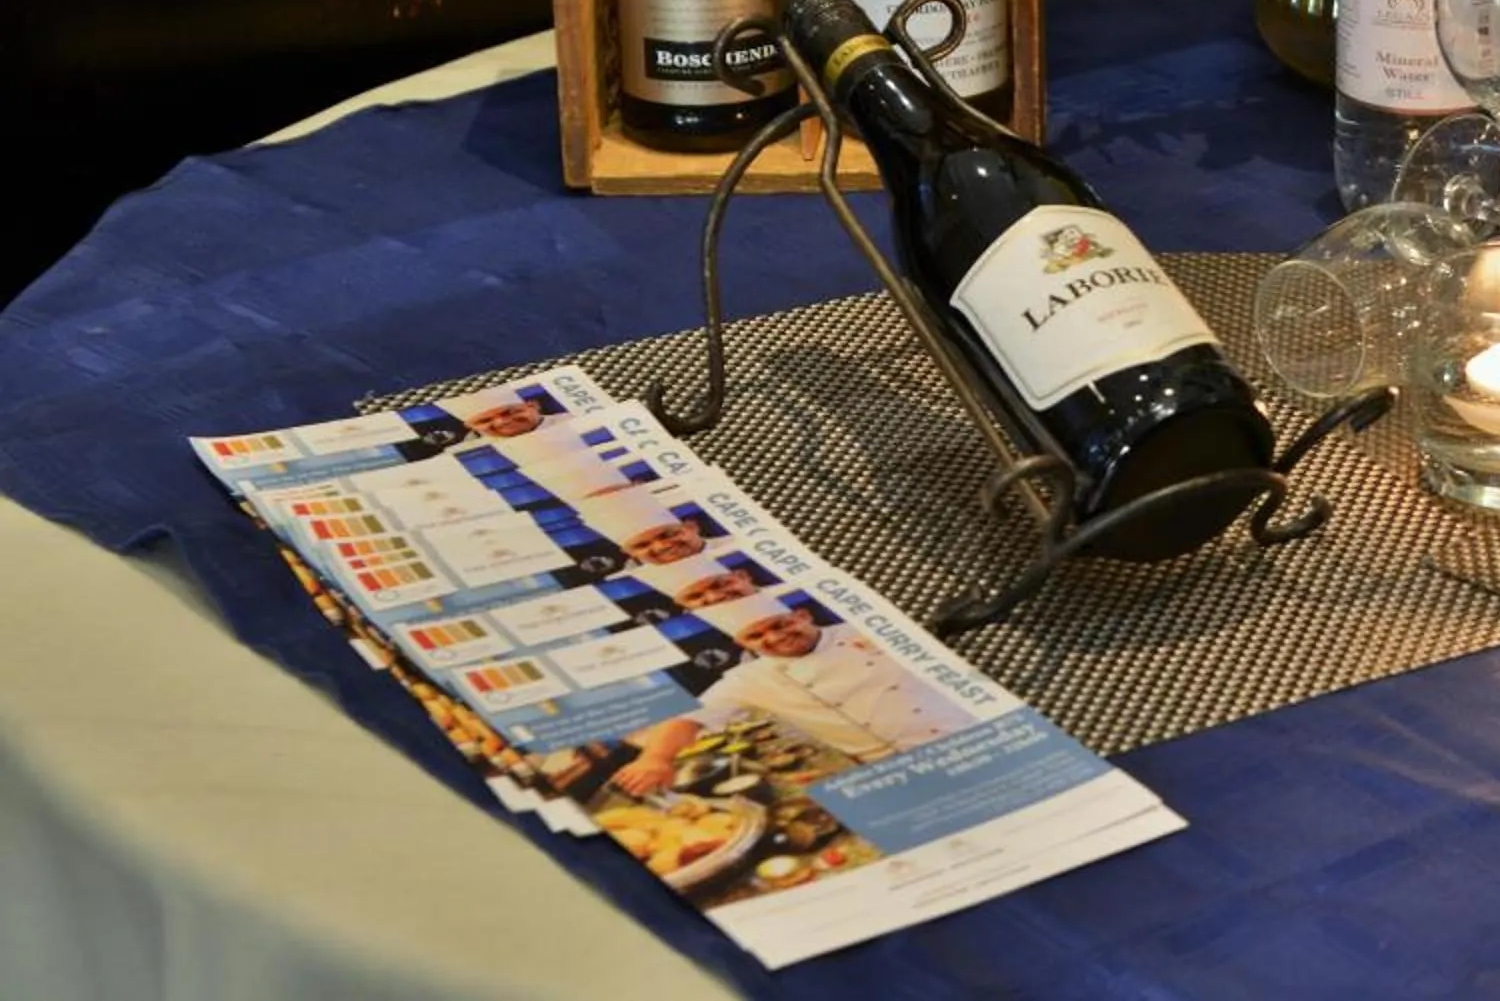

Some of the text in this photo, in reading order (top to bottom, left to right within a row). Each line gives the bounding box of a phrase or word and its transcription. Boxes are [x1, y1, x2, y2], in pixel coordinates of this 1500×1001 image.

[1375, 50, 1440, 67] Mineral
[1382, 66, 1432, 82] Water
[1020, 266, 1171, 331] LABORIE
[707, 492, 758, 530] CAPE
[754, 538, 812, 576] CAPE
[816, 578, 997, 706] CAPE CURRY FEAST
